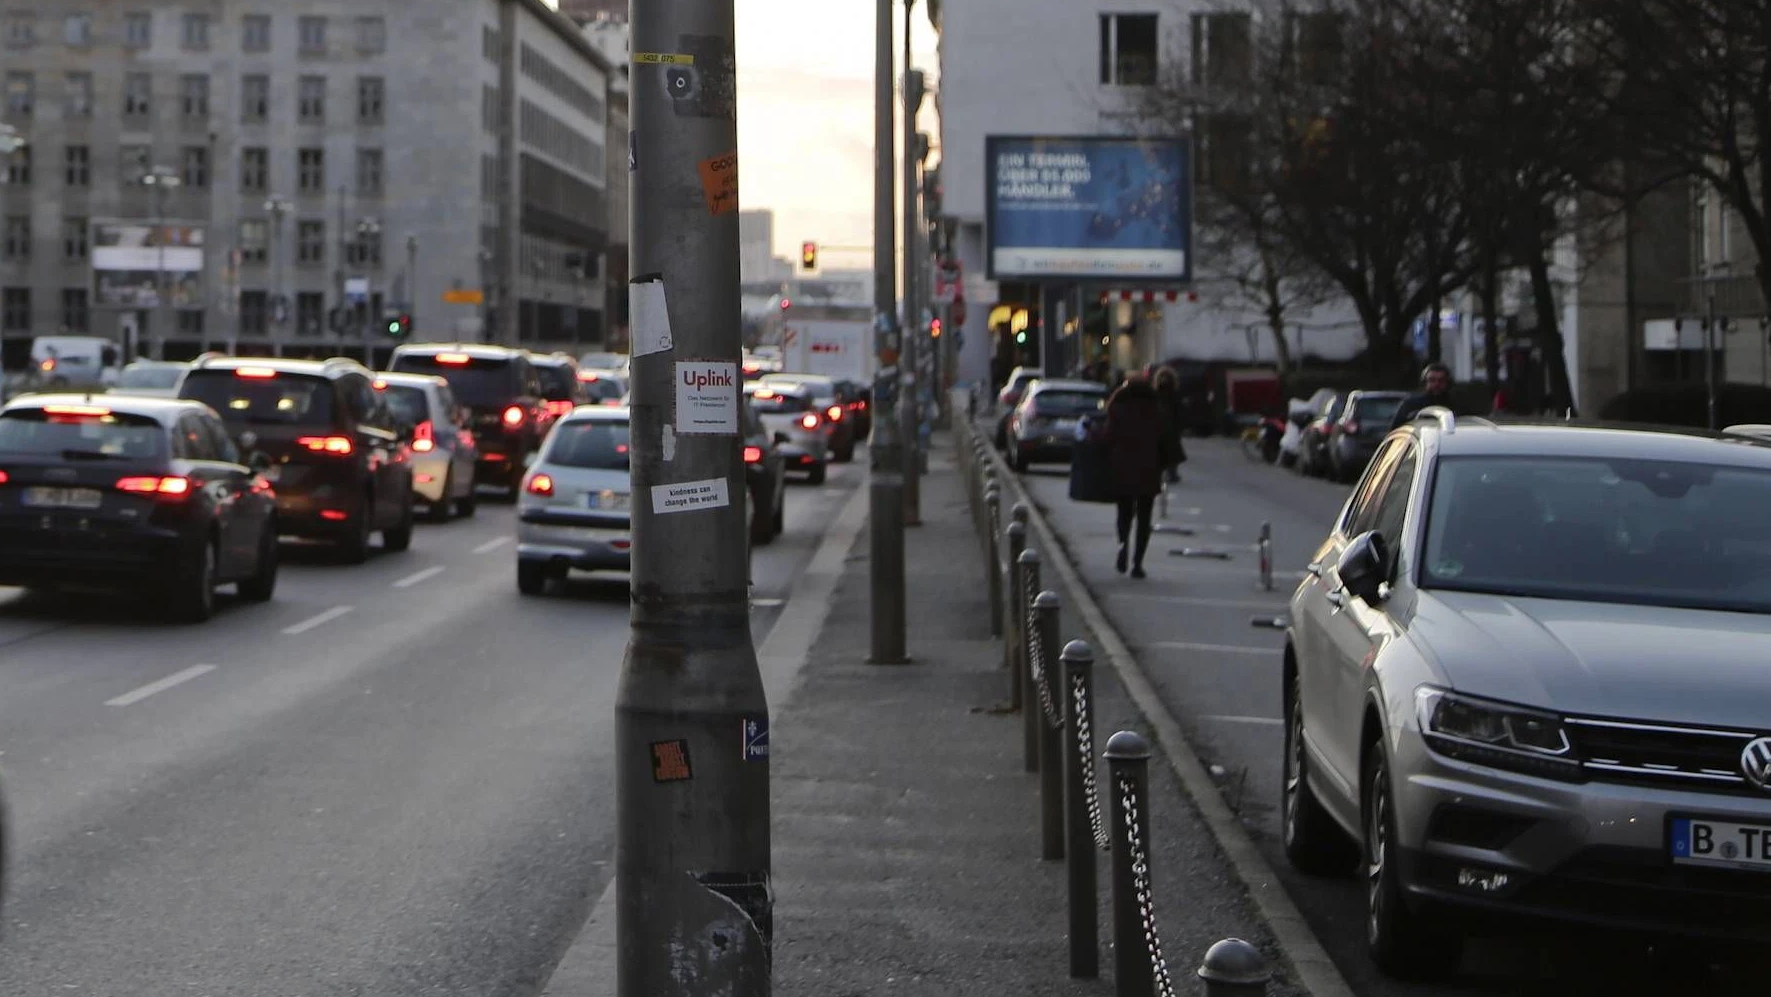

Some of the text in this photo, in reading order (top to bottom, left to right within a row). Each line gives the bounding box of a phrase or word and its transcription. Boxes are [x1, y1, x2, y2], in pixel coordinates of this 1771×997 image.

[683, 369, 732, 391] Uplink
[665, 498, 687, 506] change
[701, 494, 718, 502] world
[669, 487, 698, 496] kindness
[1693, 824, 1715, 854] B
